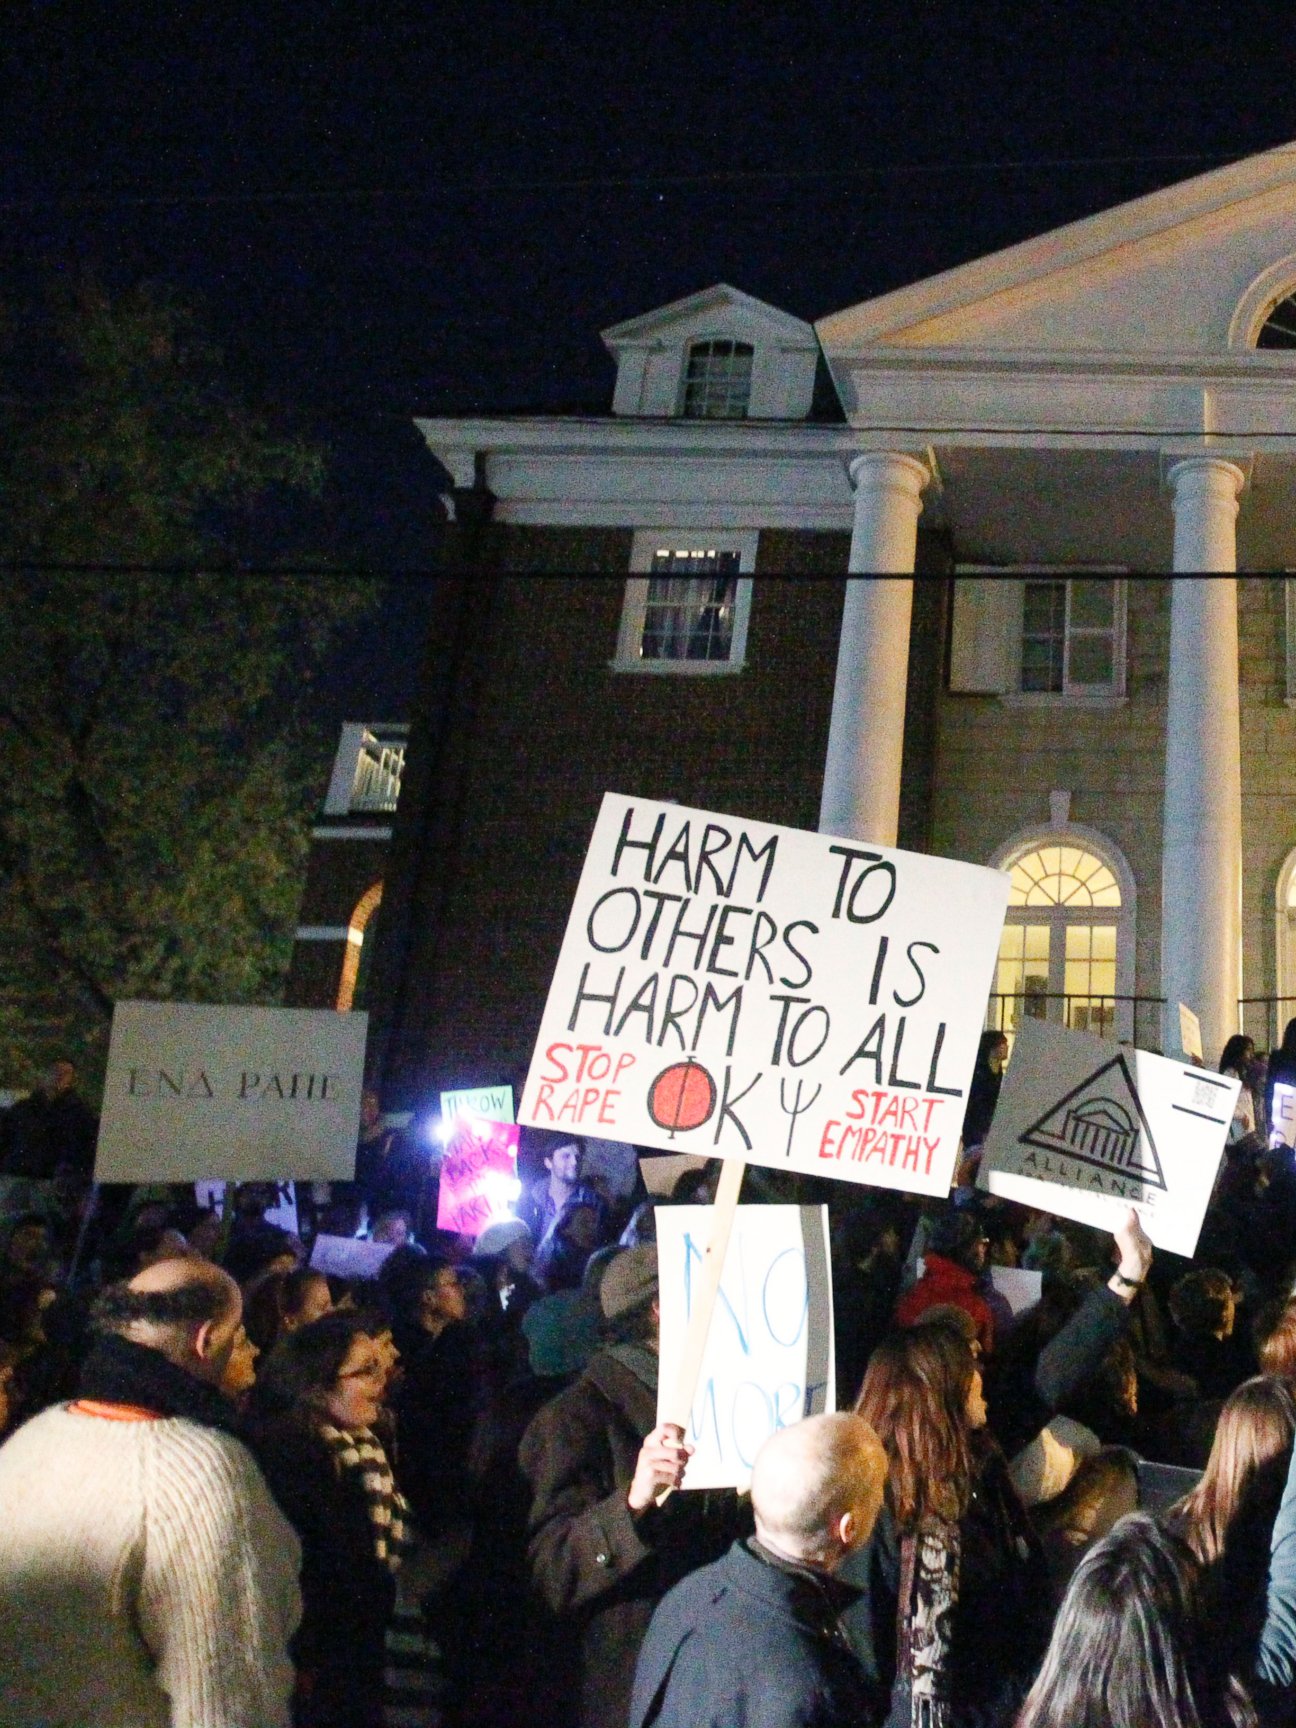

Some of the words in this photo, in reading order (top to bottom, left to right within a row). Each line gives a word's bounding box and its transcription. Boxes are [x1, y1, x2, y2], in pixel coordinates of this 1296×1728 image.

[611, 807, 779, 904] HARM
[829, 845, 898, 924] TO
[587, 886, 820, 989] OTHERS
[868, 935, 940, 1008] IS
[567, 961, 744, 1057] HARM
[769, 994, 831, 1067] TO
[839, 1012, 964, 1098] ALL
[540, 1042, 636, 1085] STOP
[531, 1084, 622, 1126] RAPE
[846, 1089, 944, 1134] START
[819, 1120, 942, 1176] EMPATHY
[1021, 1151, 1158, 1206] ALLIANCE
[683, 1231, 809, 1356] NO
